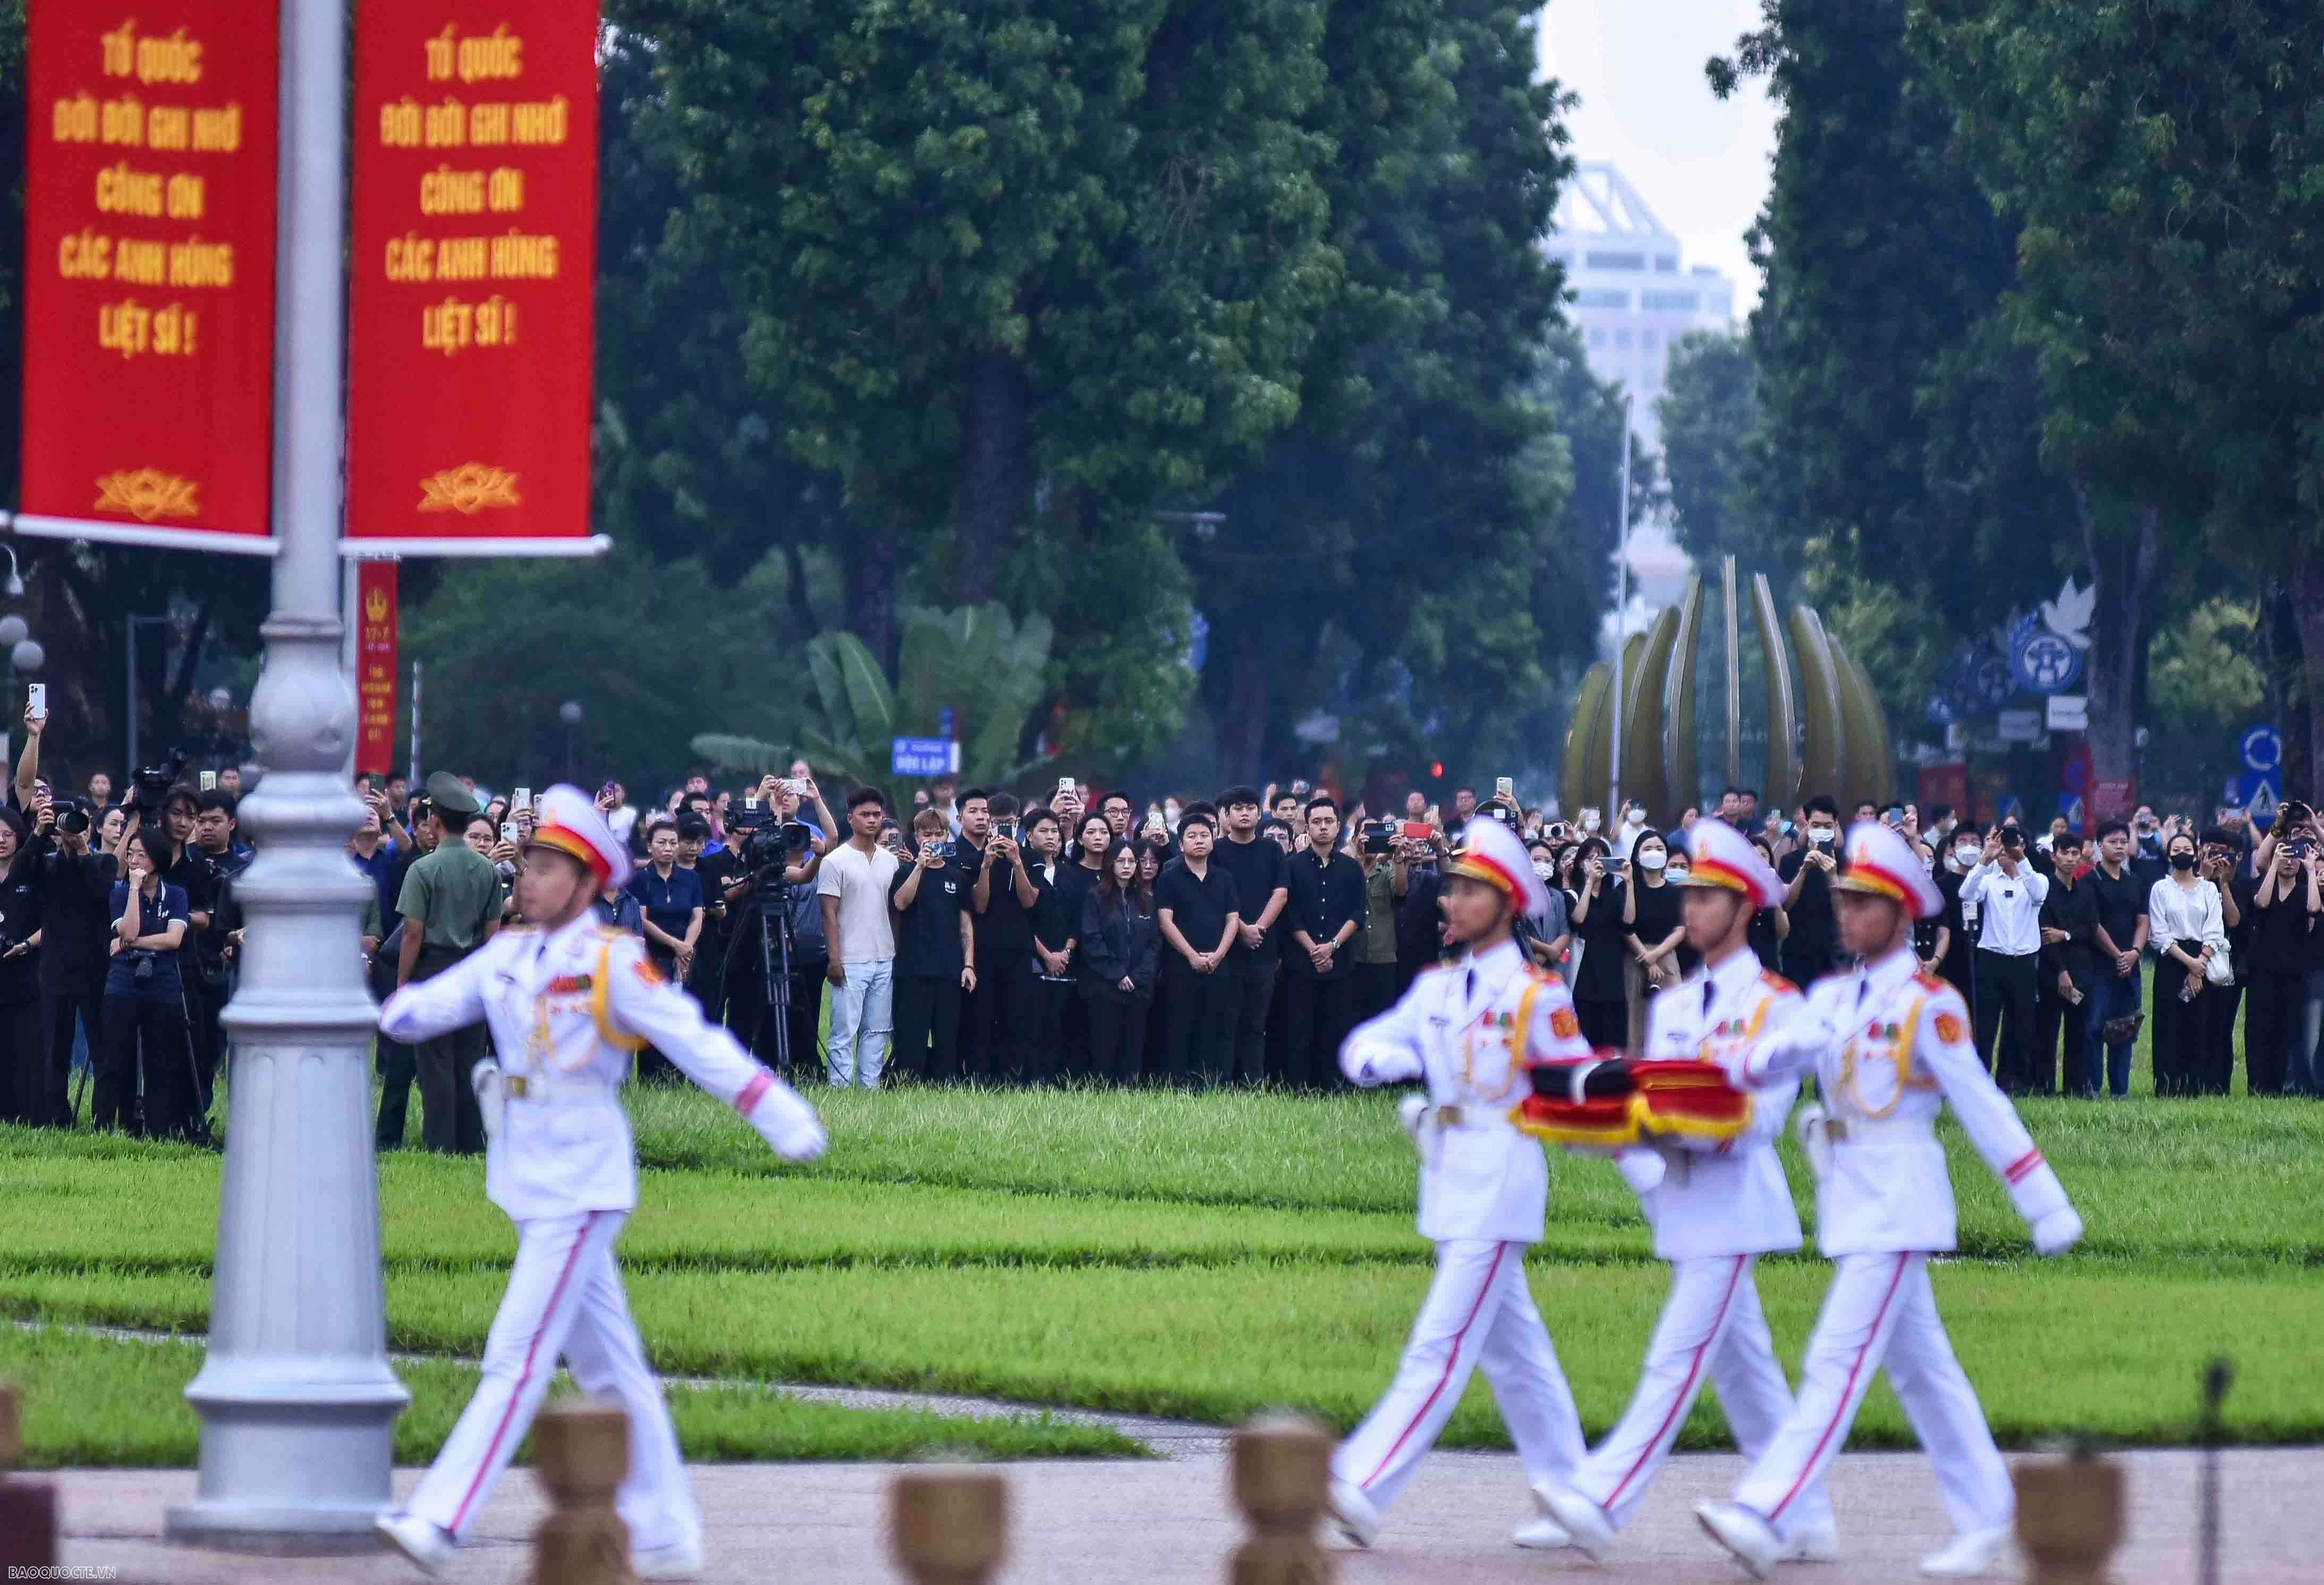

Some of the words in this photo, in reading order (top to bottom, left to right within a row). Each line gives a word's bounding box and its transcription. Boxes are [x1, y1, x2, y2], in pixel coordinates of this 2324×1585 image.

[147, 104, 191, 150] GHI
[469, 102, 511, 147] GHI
[95, 162, 165, 218] CÔNG
[419, 163, 487, 216] CÔNG
[58, 227, 112, 279] CÁC
[113, 236, 167, 286] ANH
[167, 236, 233, 287] HÙNG
[385, 230, 436, 283] CÁC
[434, 236, 490, 282] ANH
[489, 226, 559, 279] HÙNG
[99, 298, 152, 360] LIỆT
[422, 295, 476, 357] LIỆT
